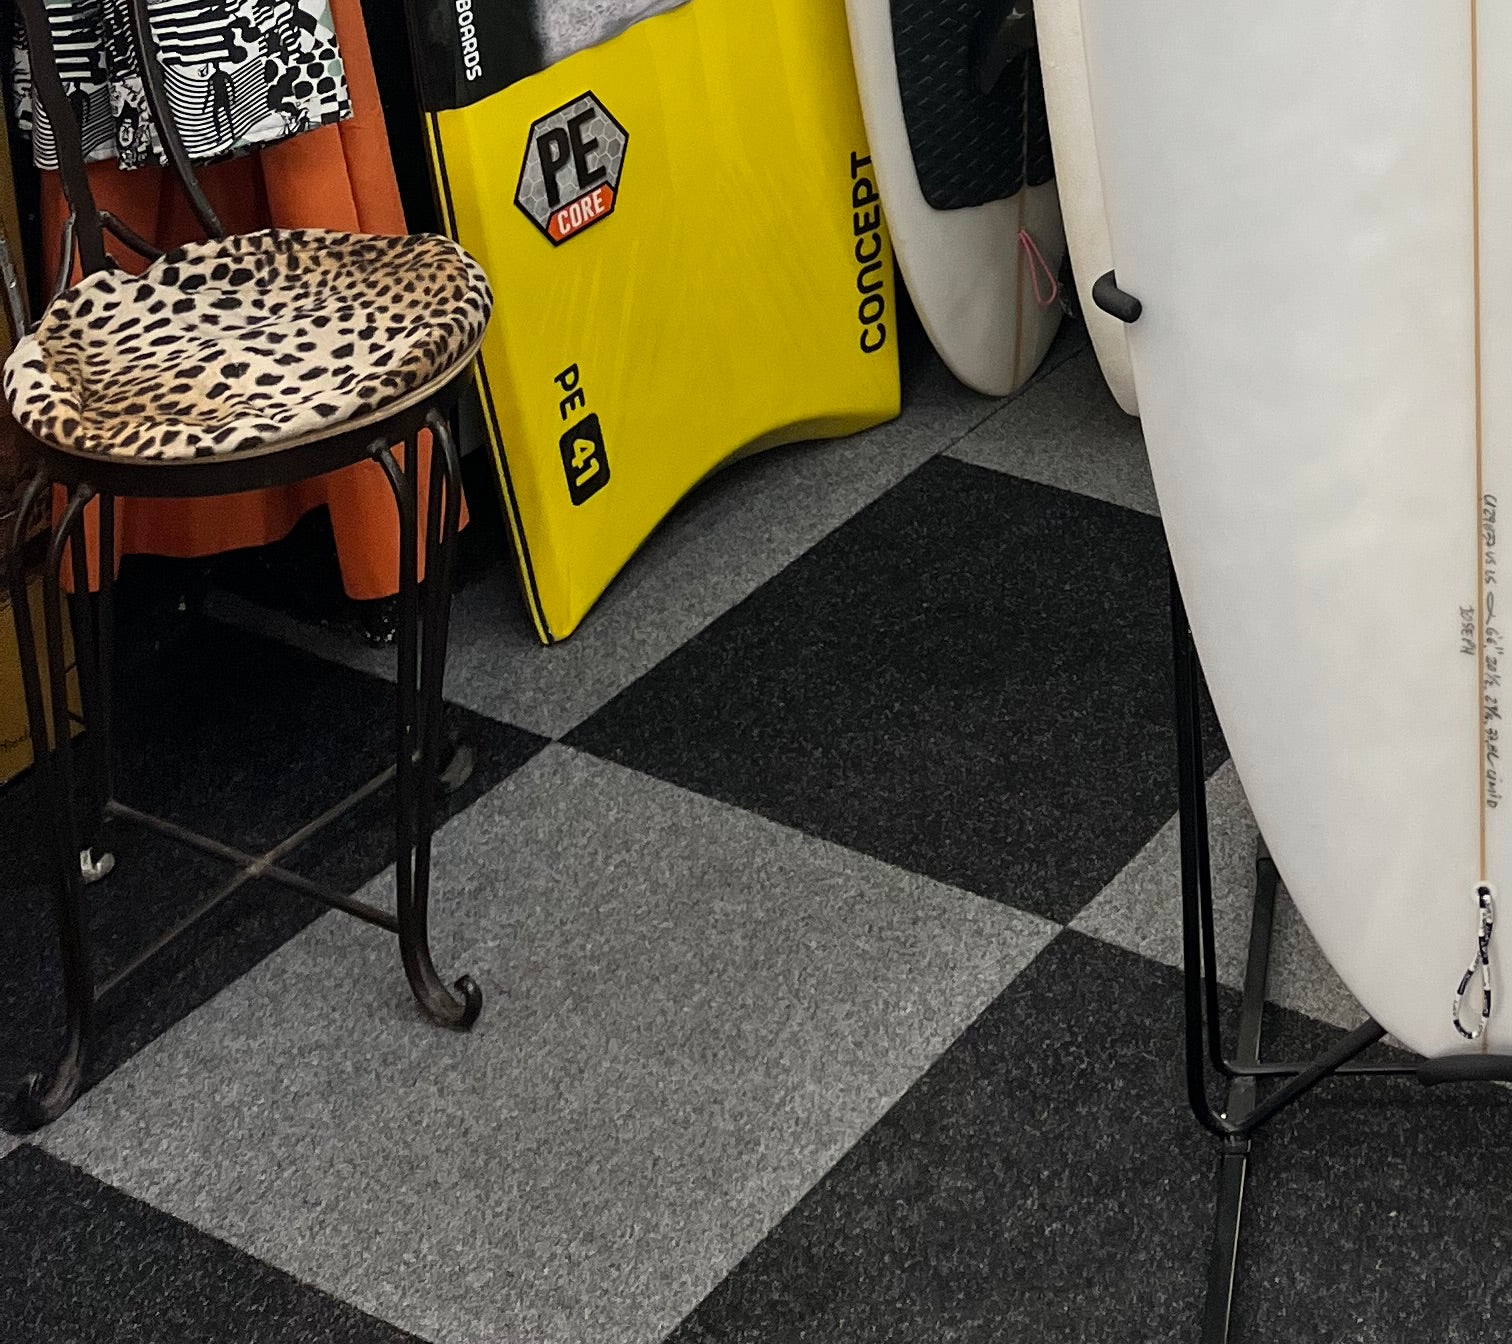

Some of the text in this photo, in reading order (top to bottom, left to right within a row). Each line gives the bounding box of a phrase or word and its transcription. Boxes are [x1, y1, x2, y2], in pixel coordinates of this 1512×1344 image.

[535, 107, 605, 210] PE
[556, 187, 606, 237] CORE
[849, 151, 887, 355] CONCEPT
[553, 362, 601, 492] PE 41
